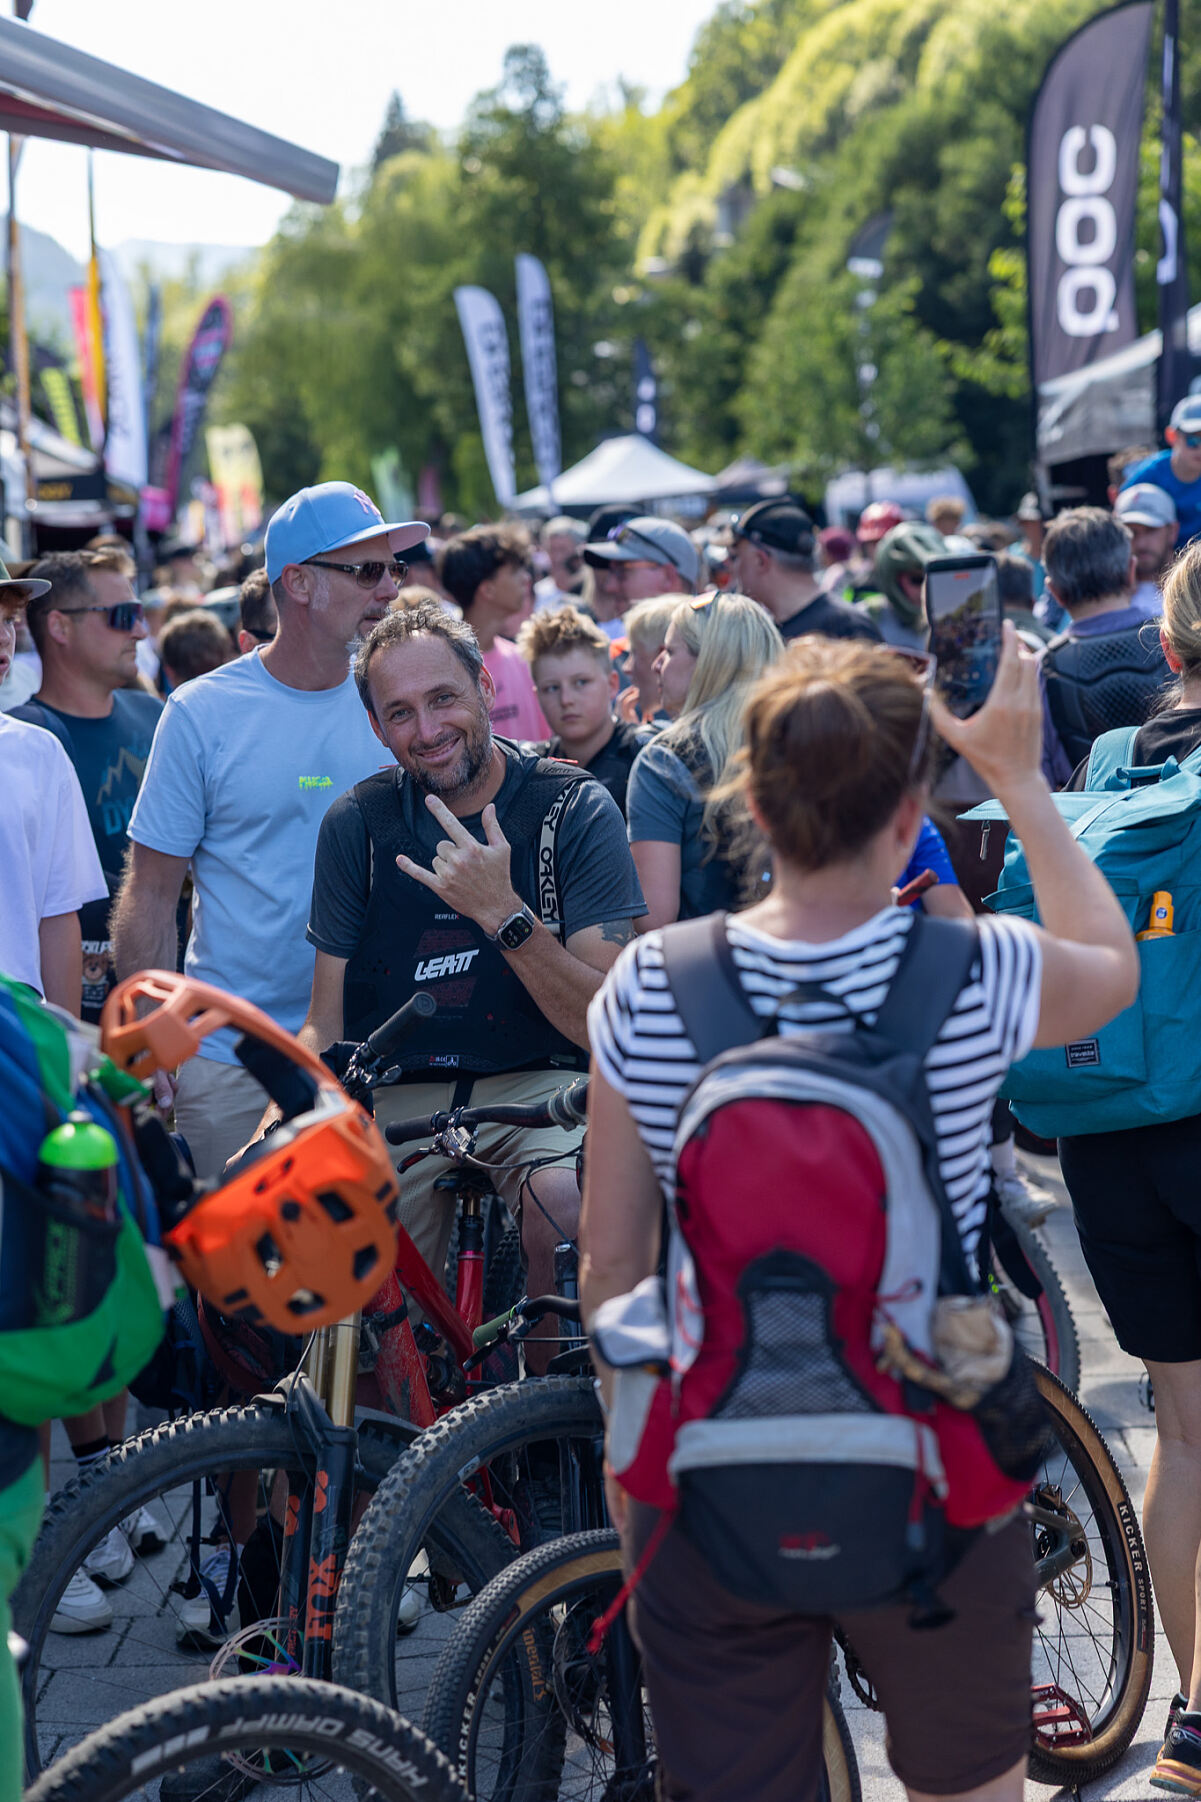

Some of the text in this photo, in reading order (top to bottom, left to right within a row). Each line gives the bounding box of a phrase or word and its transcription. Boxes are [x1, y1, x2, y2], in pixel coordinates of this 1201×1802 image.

[540, 846, 561, 923] OAKLEY
[414, 949, 480, 982] LEATT
[1119, 1505, 1143, 1572] KICKER
[1138, 1578, 1147, 1611] SPORT
[287, 1605, 299, 1656] FACTRY
[306, 1553, 342, 1640] FOX
[522, 1626, 546, 1691] inental
[457, 1647, 493, 1777] KICKER SPORT
[220, 1713, 428, 1788] HANS DAMPF
